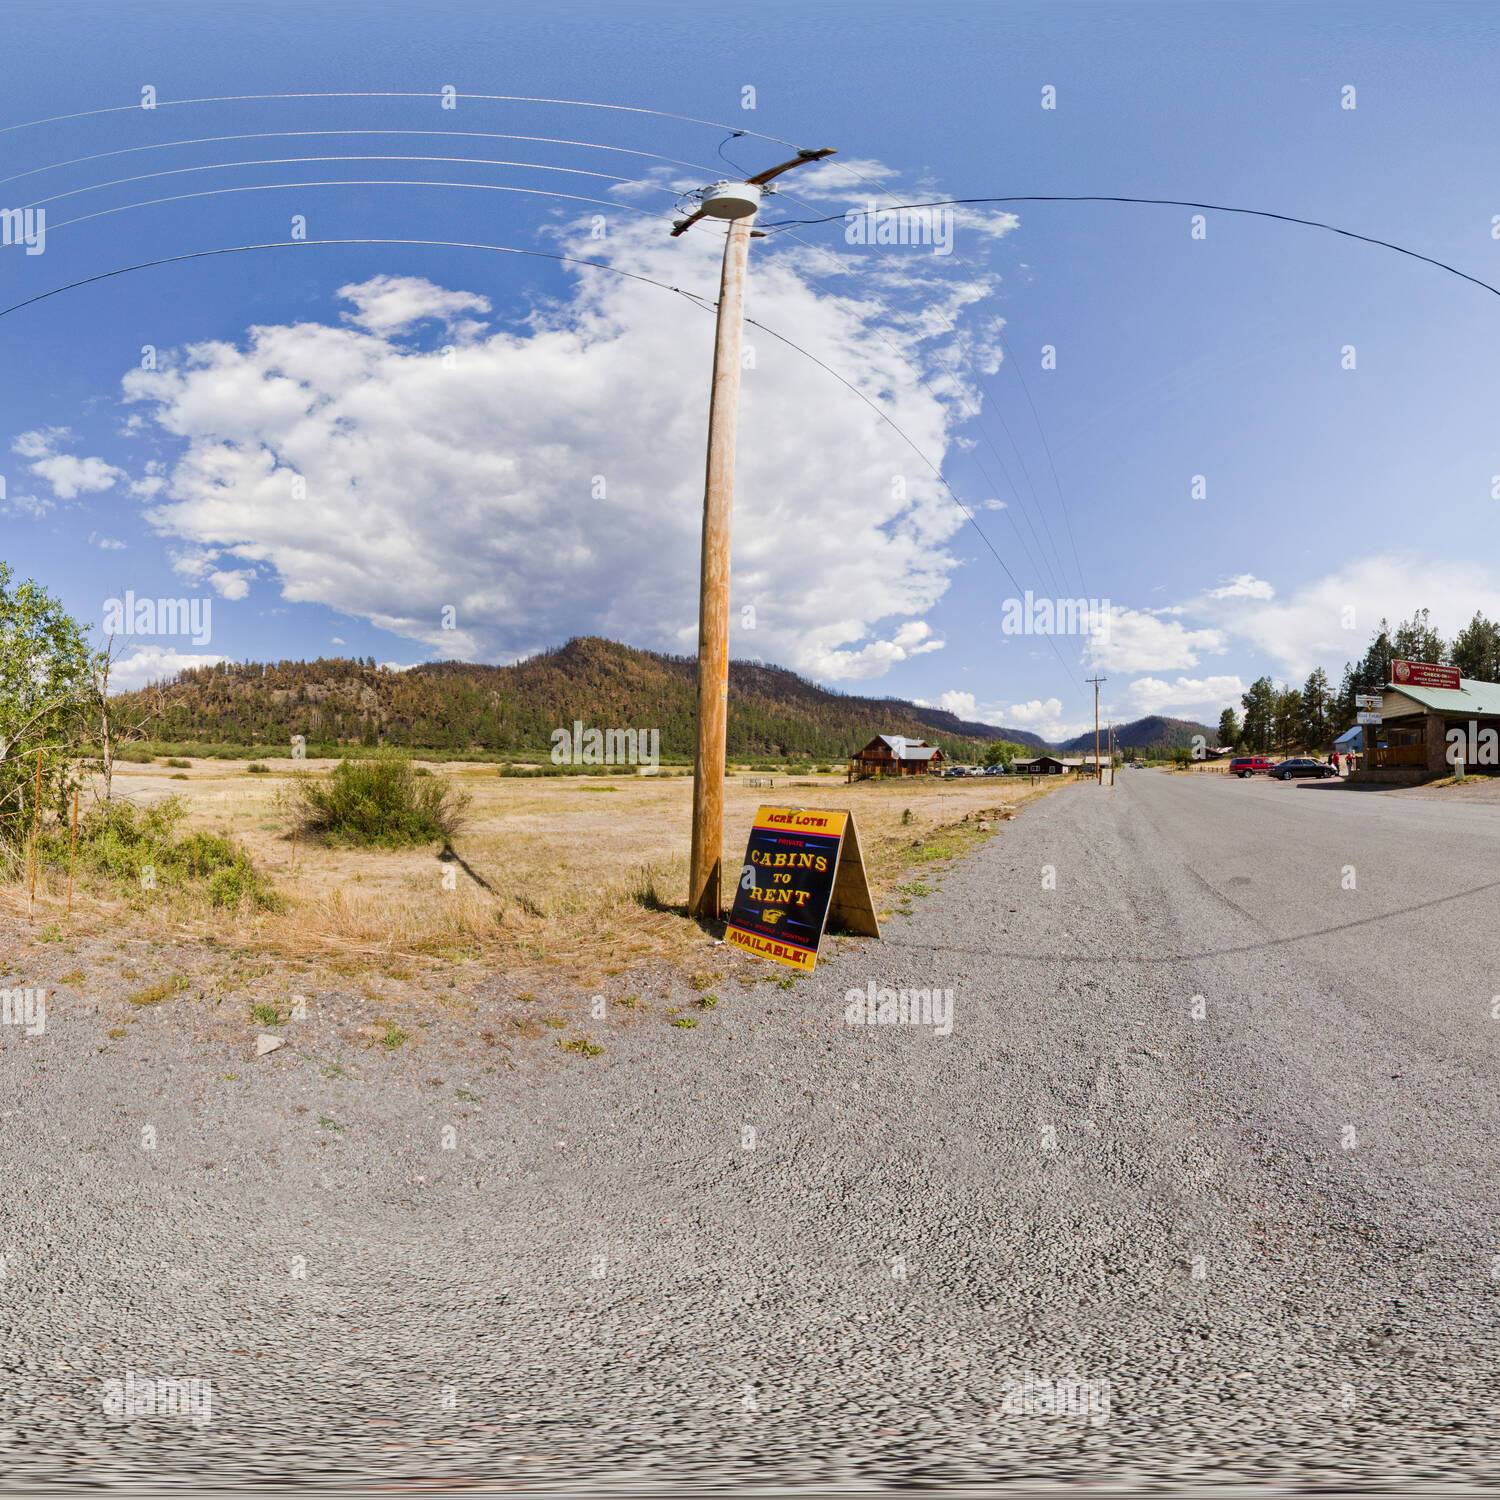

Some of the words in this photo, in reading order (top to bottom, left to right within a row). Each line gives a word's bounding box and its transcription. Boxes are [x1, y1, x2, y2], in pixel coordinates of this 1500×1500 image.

[768, 814, 792, 824] ACRE
[796, 816, 828, 827] LOTS!
[751, 850, 828, 872] CABINS
[773, 873, 791, 884] TO
[750, 886, 810, 906] RENT
[730, 930, 808, 964] AVAILABLE!
